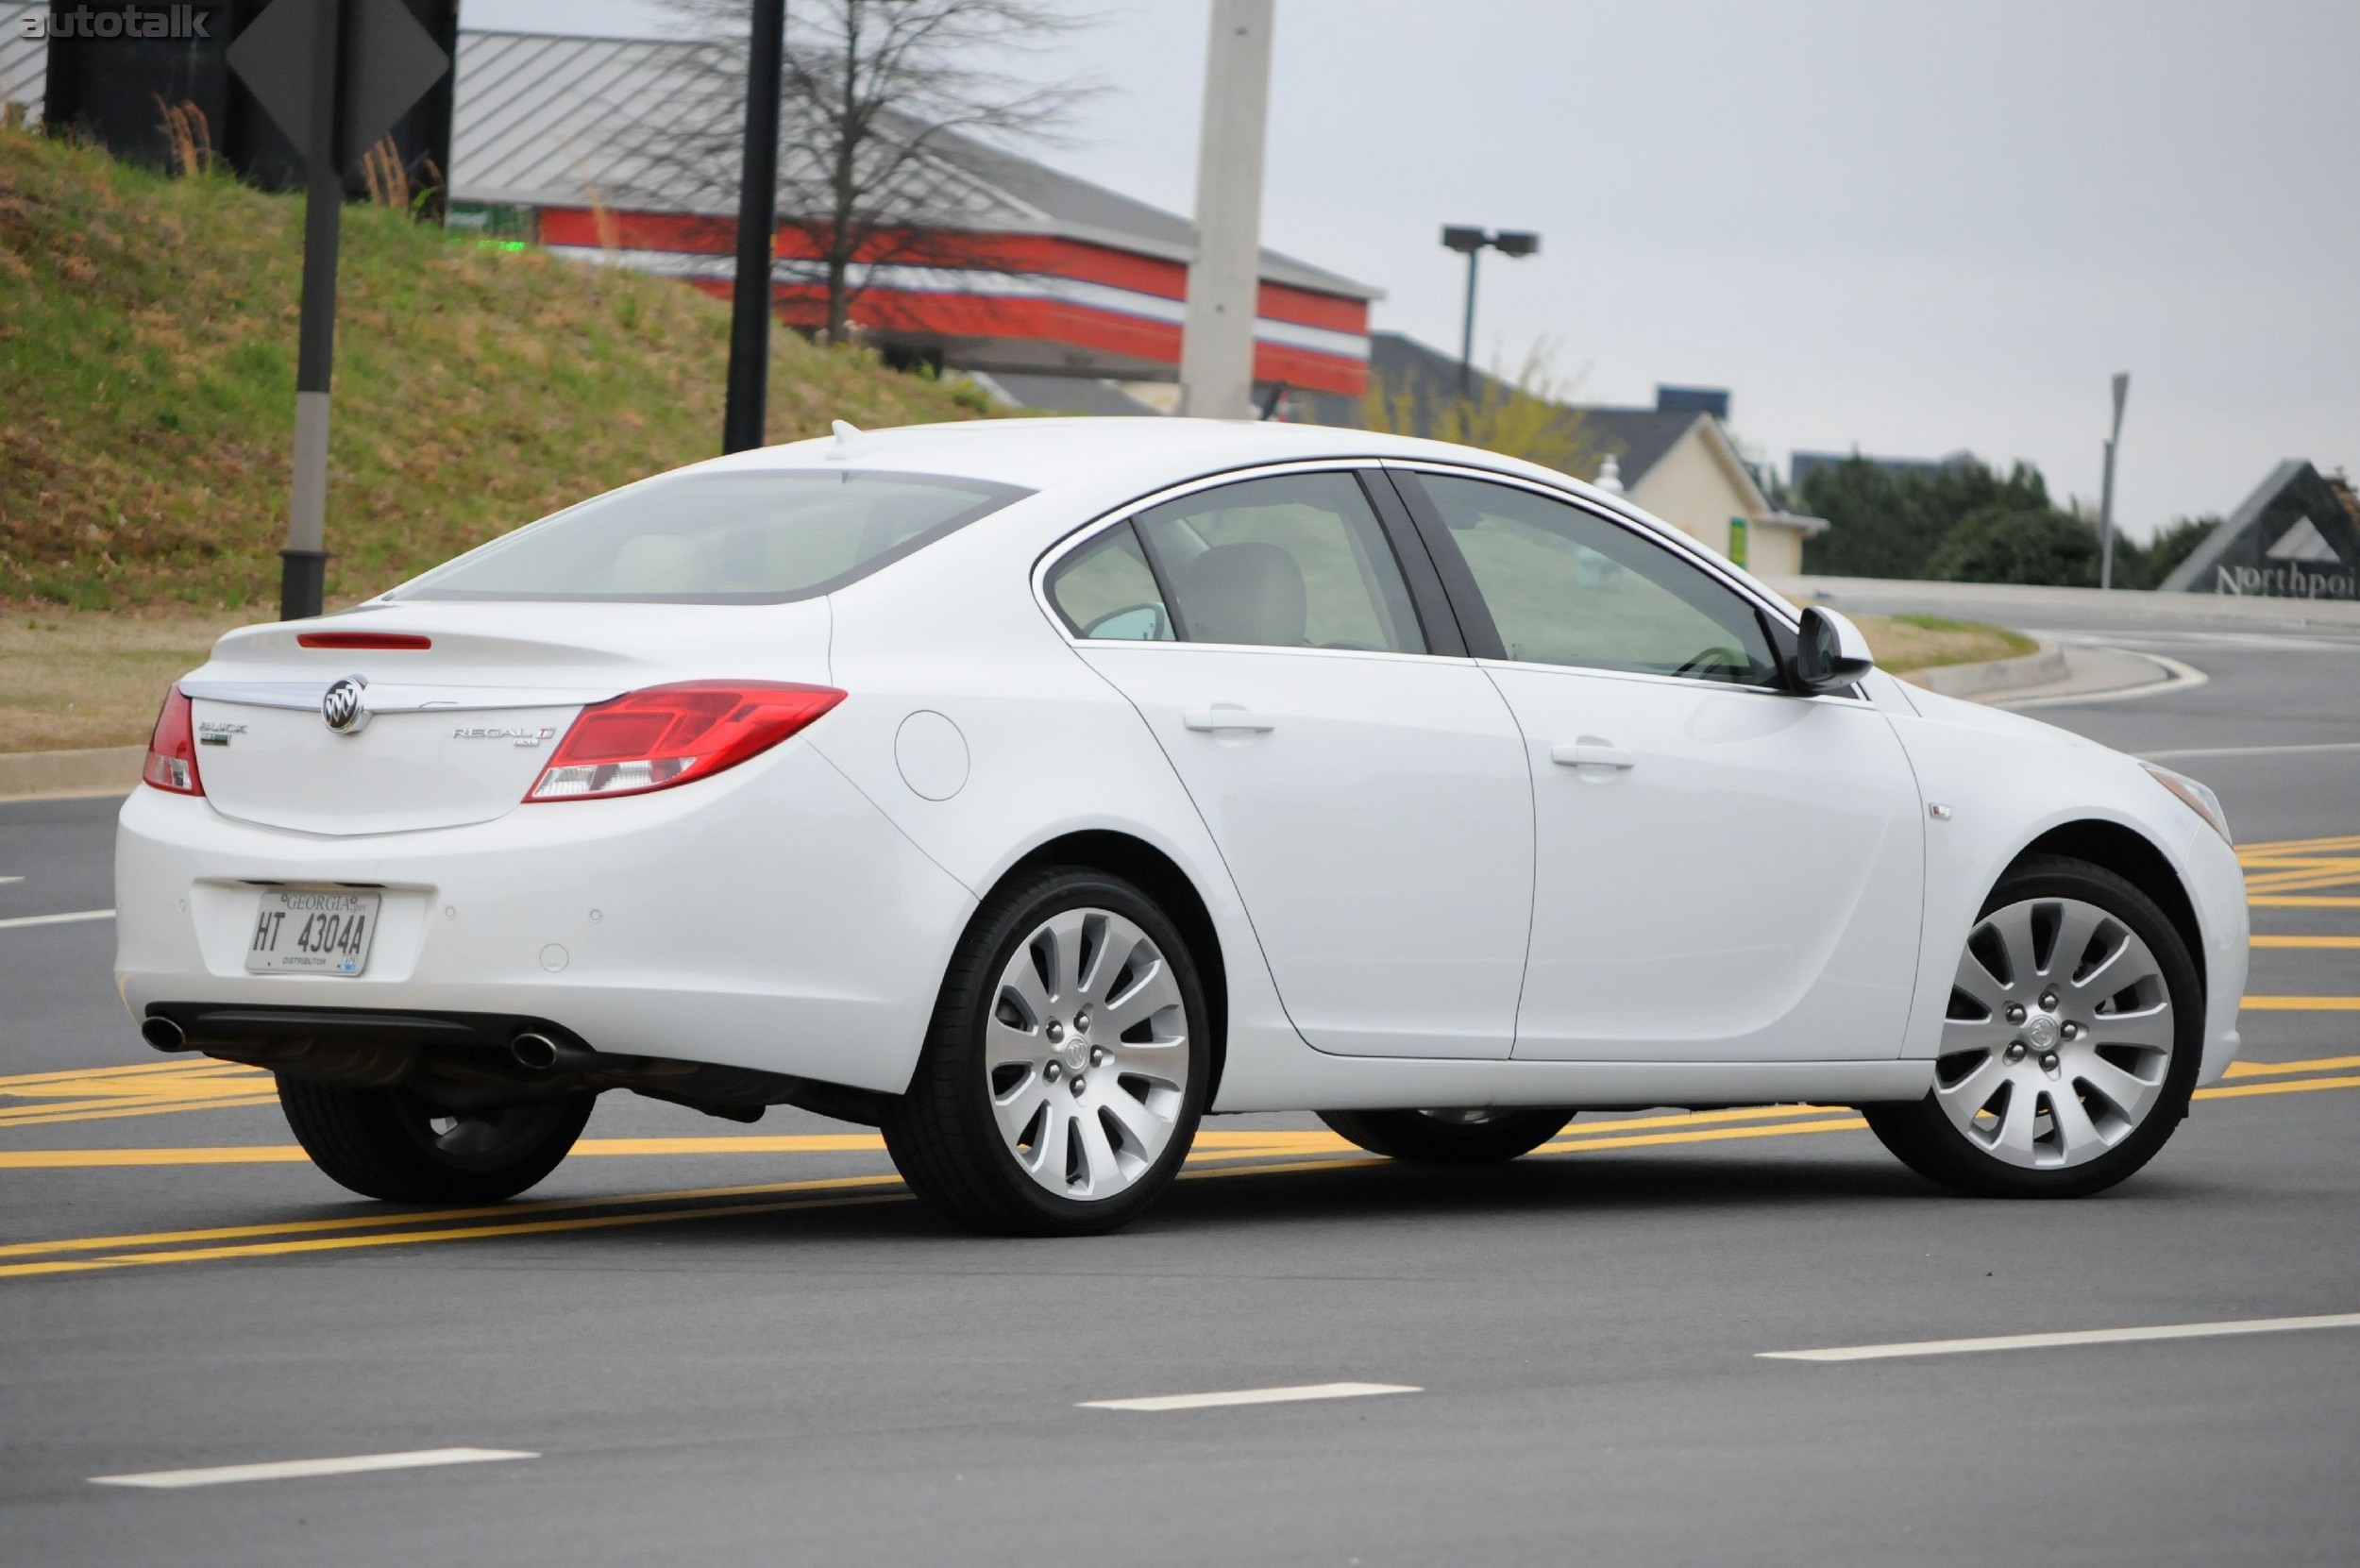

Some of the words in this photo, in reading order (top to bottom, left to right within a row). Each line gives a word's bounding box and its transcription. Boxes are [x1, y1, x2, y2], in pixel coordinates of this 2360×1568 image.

[199, 722, 248, 733] BUICK
[453, 728, 532, 738] REGAL
[253, 912, 285, 951] HT
[297, 912, 365, 953] 4304A
[282, 956, 327, 966] DISTRIBUTOR
